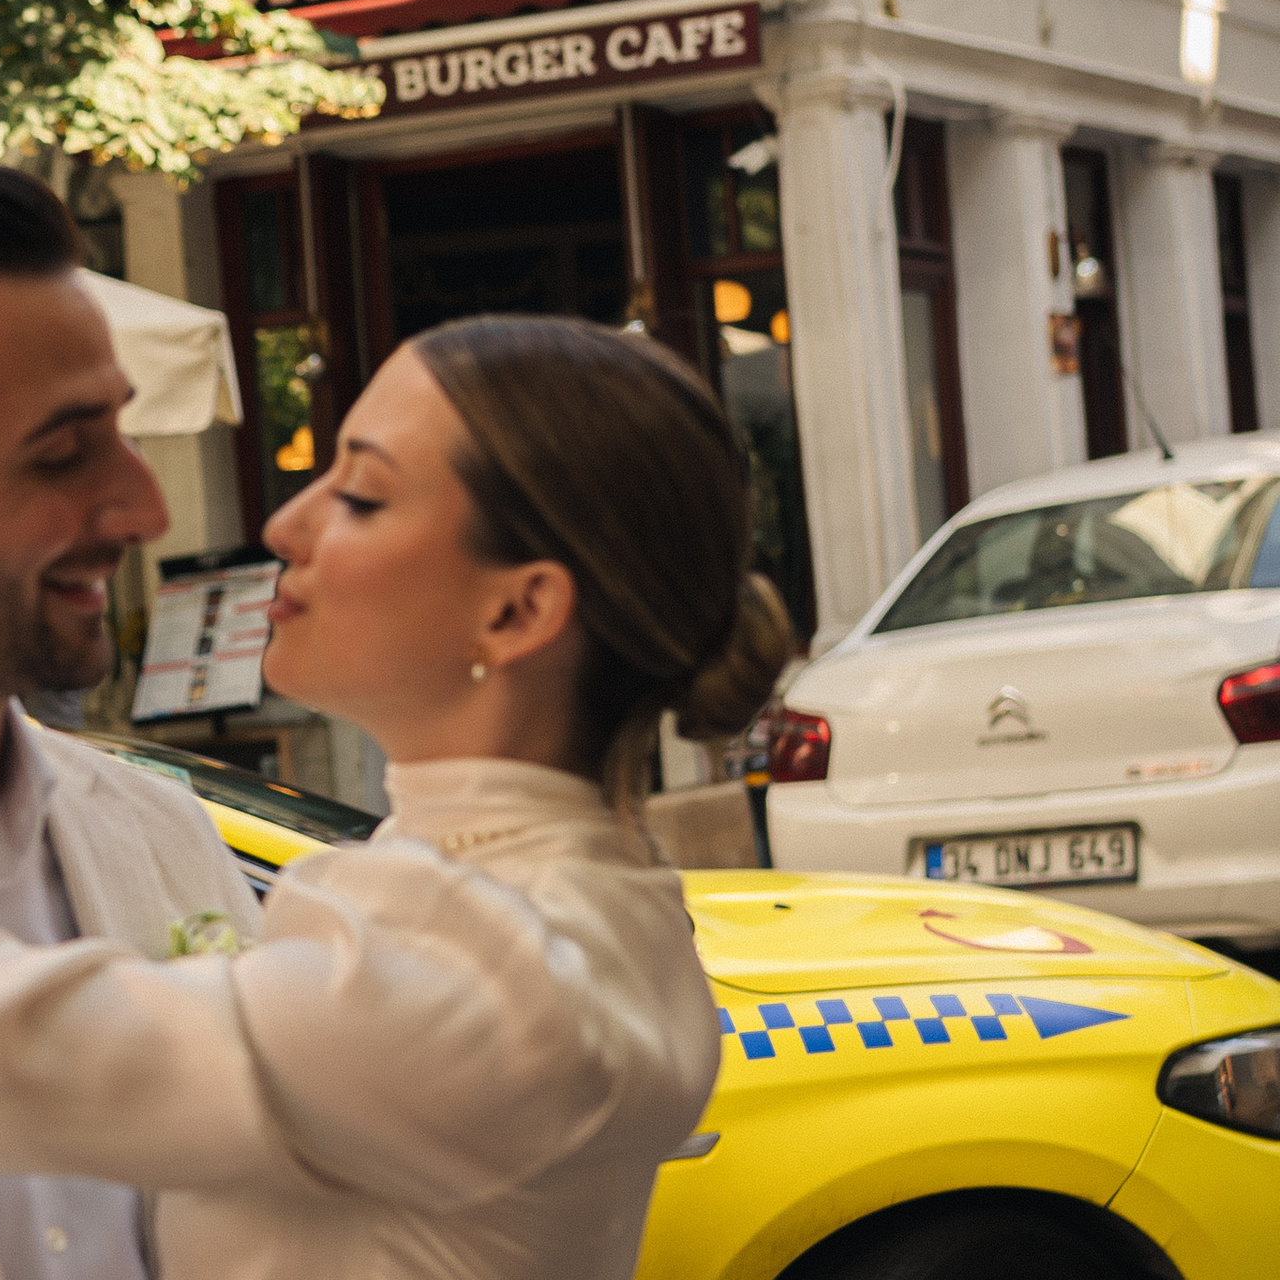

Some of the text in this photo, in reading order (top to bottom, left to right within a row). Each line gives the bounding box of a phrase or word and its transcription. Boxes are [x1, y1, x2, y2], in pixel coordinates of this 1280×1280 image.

[393, 10, 747, 102] BURGER CAFE
[1070, 832, 1126, 870] 649
